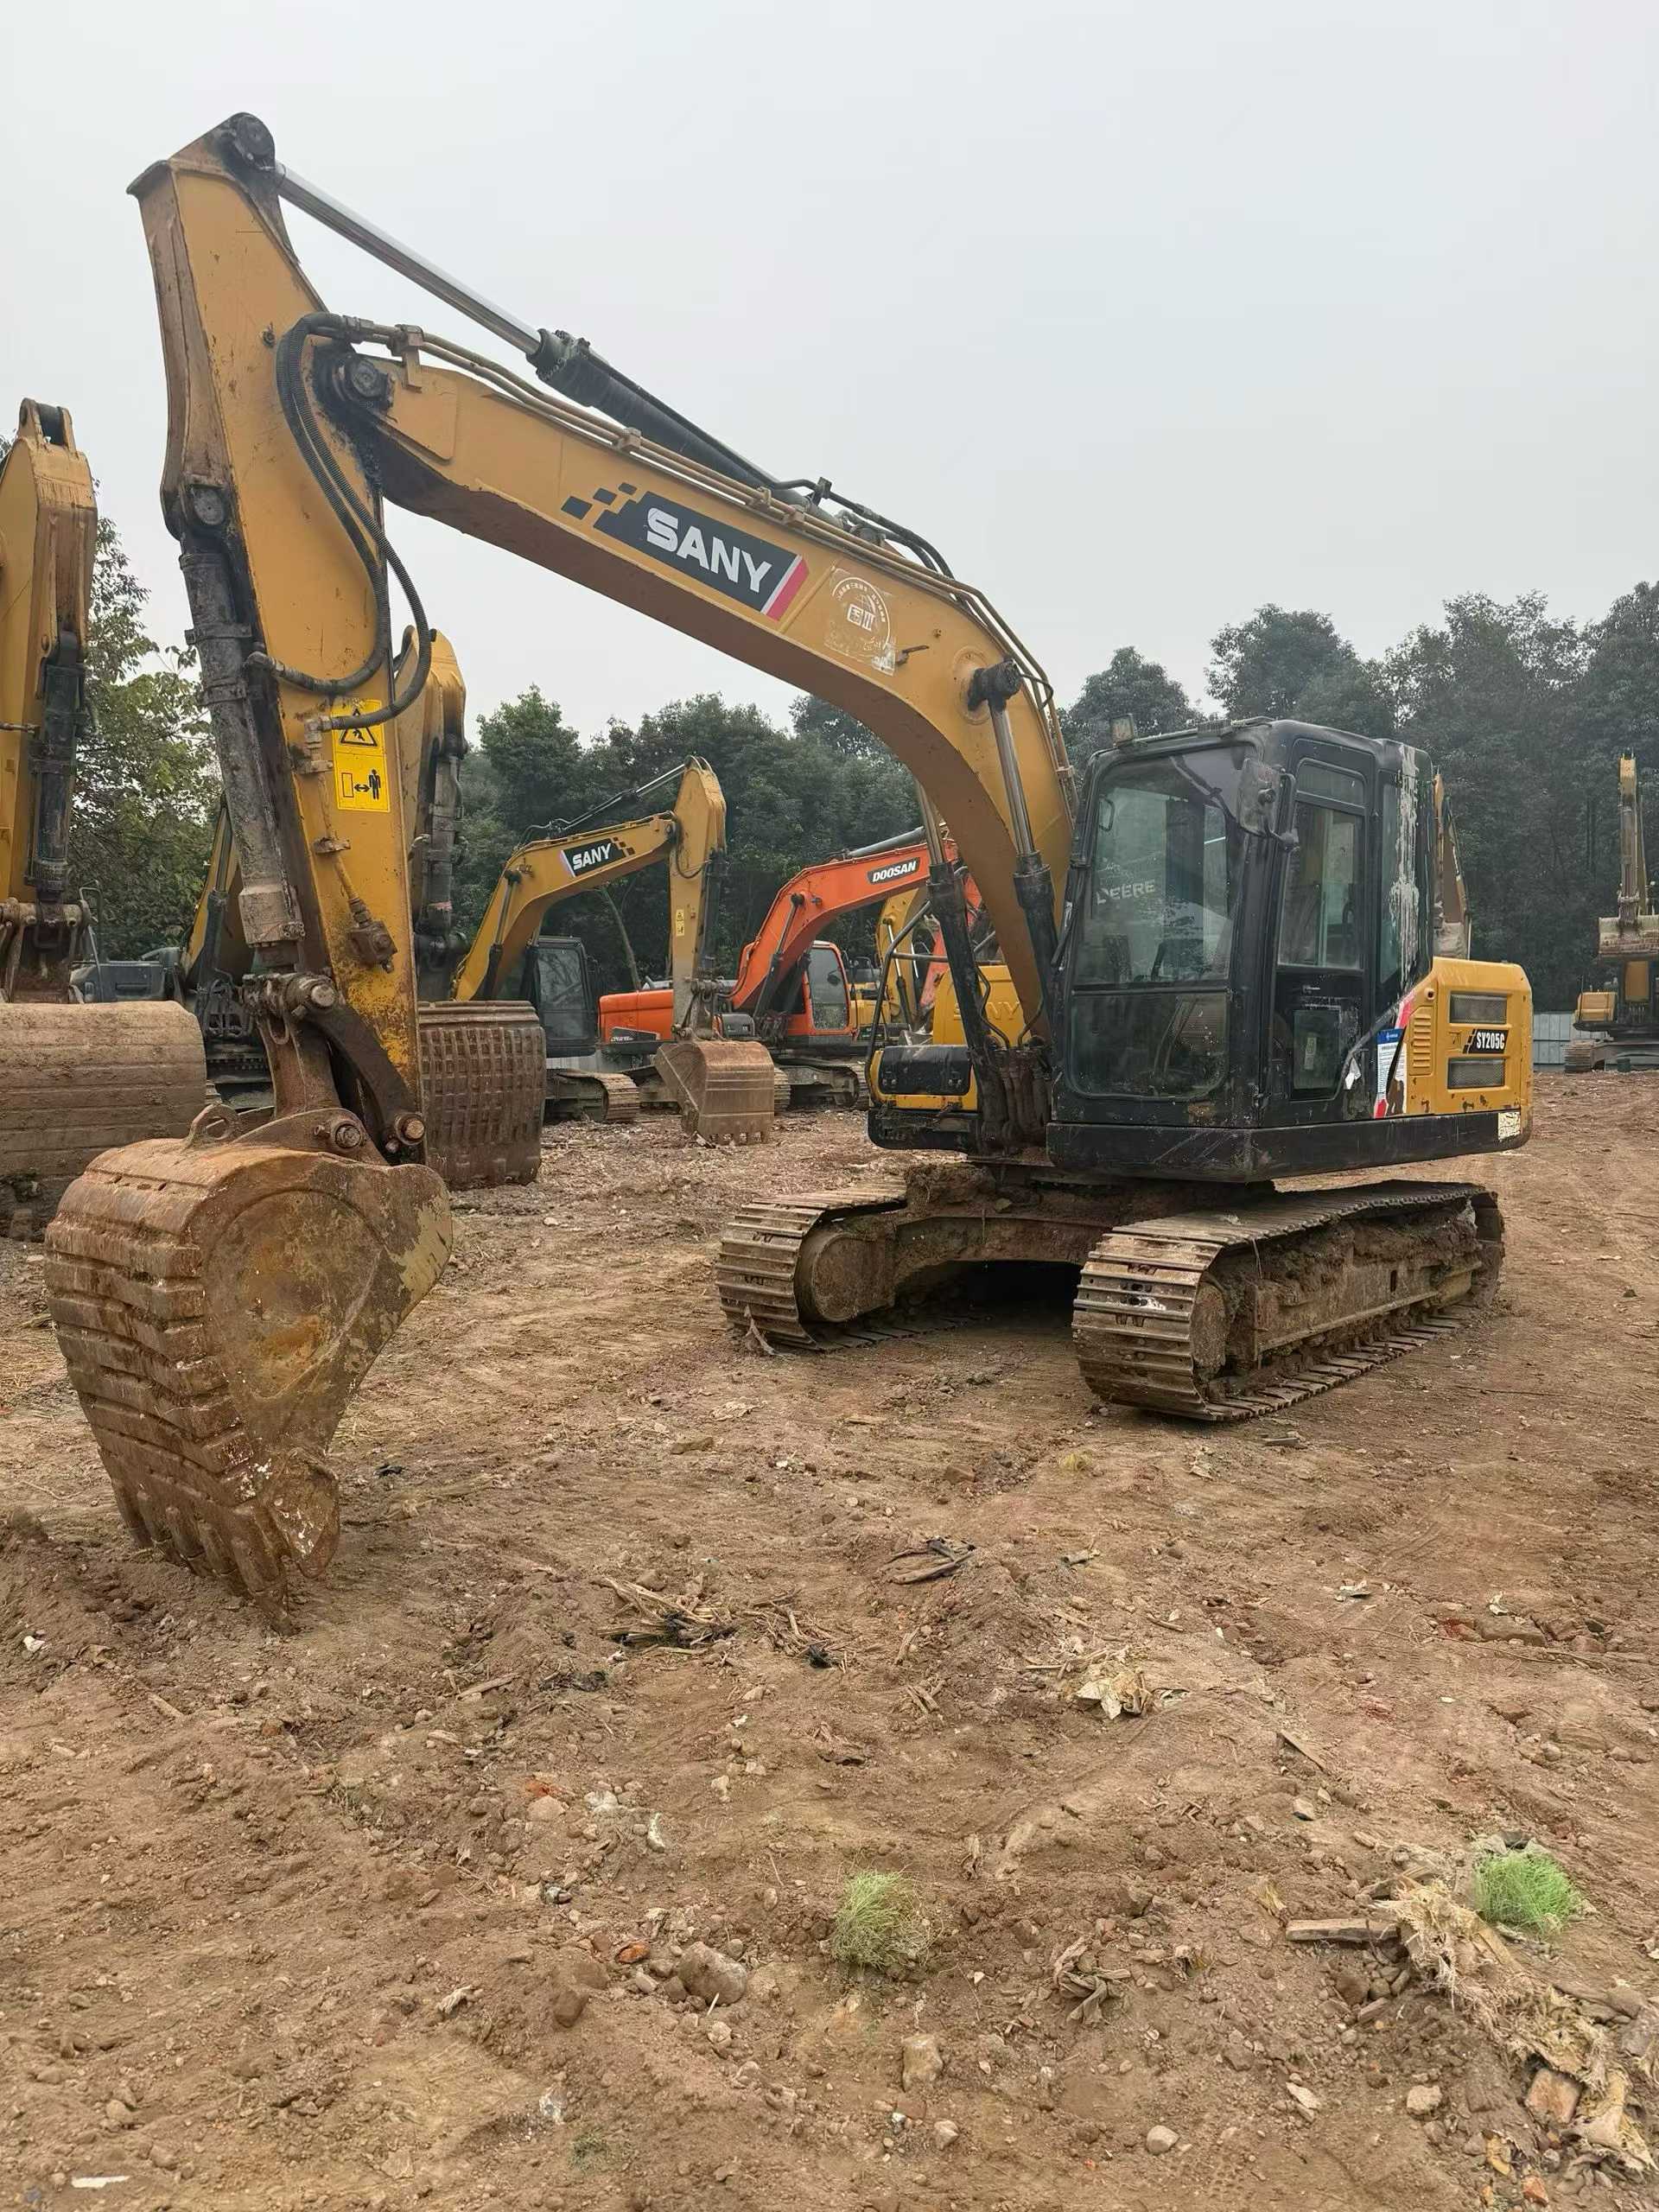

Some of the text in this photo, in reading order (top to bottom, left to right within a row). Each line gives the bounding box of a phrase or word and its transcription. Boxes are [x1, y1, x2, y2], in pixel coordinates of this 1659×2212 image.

[647, 507, 772, 593] SANY
[572, 842, 612, 870] SANY
[872, 861, 917, 882] DOOSAN
[1476, 1031, 1505, 1050] SY205C
